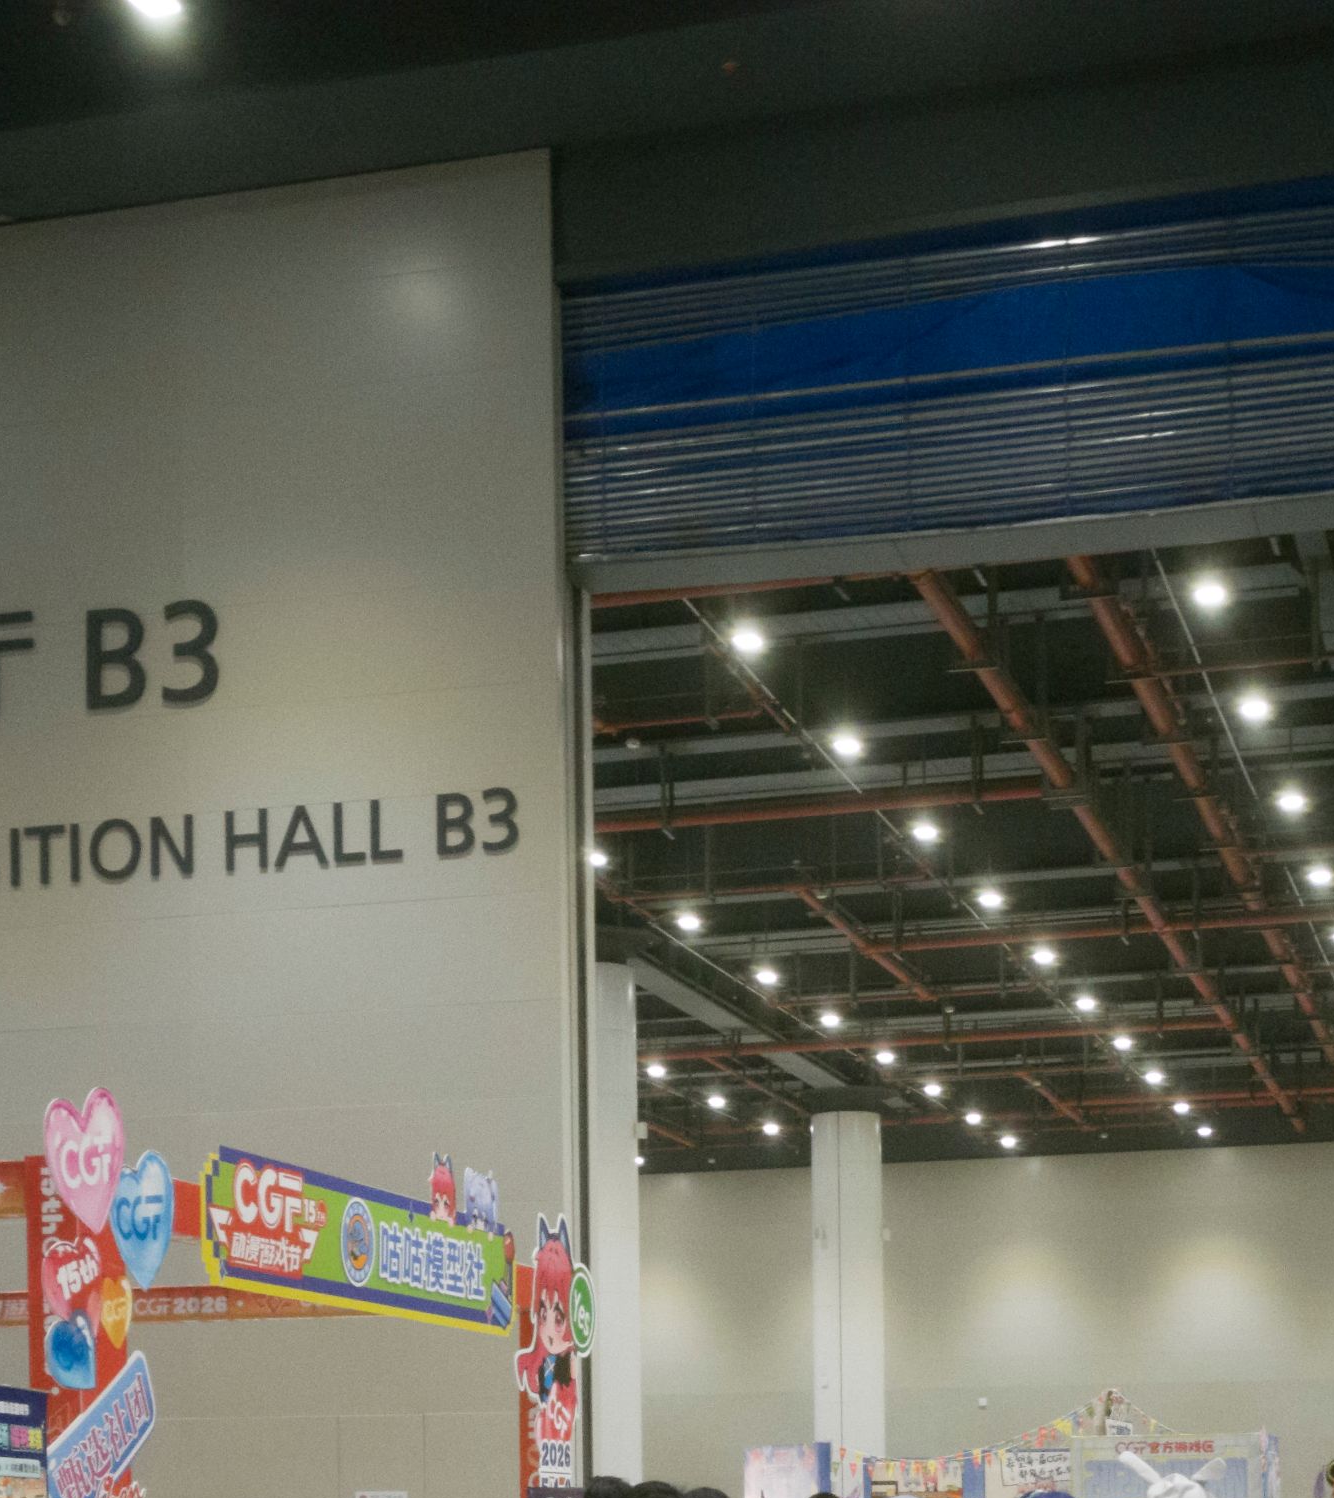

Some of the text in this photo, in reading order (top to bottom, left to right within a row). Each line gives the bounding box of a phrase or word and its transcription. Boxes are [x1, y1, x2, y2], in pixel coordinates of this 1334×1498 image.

[84, 599, 220, 711] B3
[224, 798, 404, 875] HALL
[435, 786, 521, 860] B3
[60, 1130, 111, 1189] CGT
[116, 1194, 163, 1241] CGT
[236, 1162, 304, 1232] CGT
[230, 1230, 303, 1273] 动漫游戏节
[378, 1219, 488, 1301] 咕咕模型社
[56, 1253, 100, 1300] 15th
[573, 1290, 591, 1337] Yes
[547, 1395, 572, 1440] CGT
[541, 1441, 572, 1468] 2026
